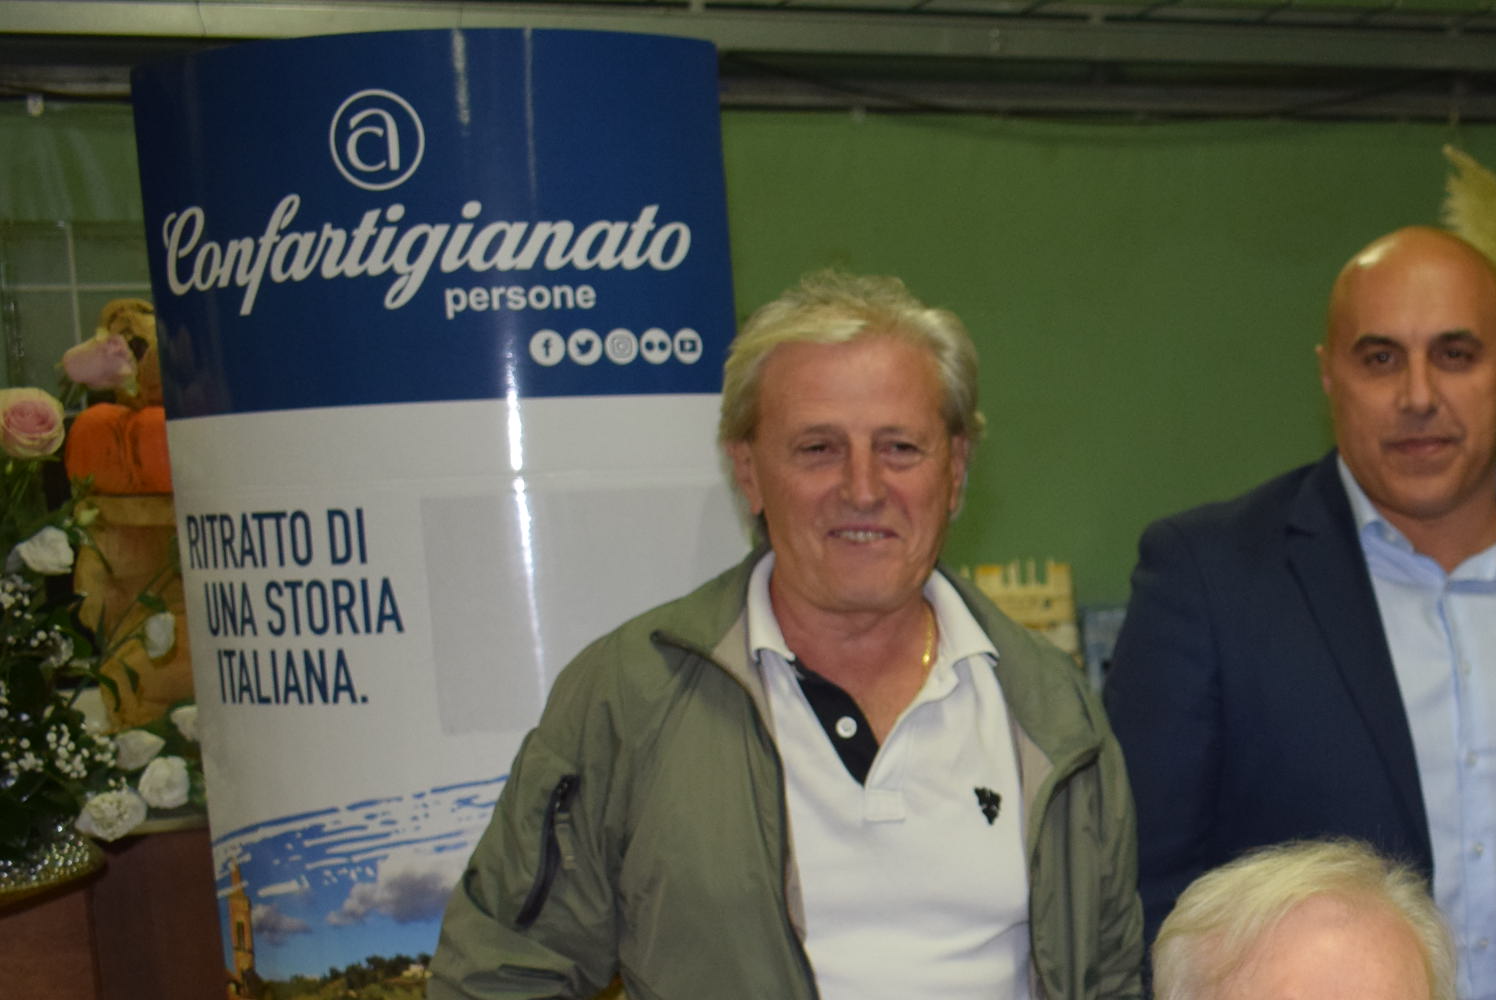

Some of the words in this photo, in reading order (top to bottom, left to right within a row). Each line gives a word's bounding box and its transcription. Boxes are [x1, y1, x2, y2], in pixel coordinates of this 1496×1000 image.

[163, 194, 691, 315] Confartigianato
[444, 284, 597, 319] persone
[186, 510, 313, 569] RITRATTO
[327, 508, 367, 565] DI
[204, 582, 258, 637] UNA
[265, 577, 404, 636] STORIA
[217, 648, 368, 704] ITALIANA.
